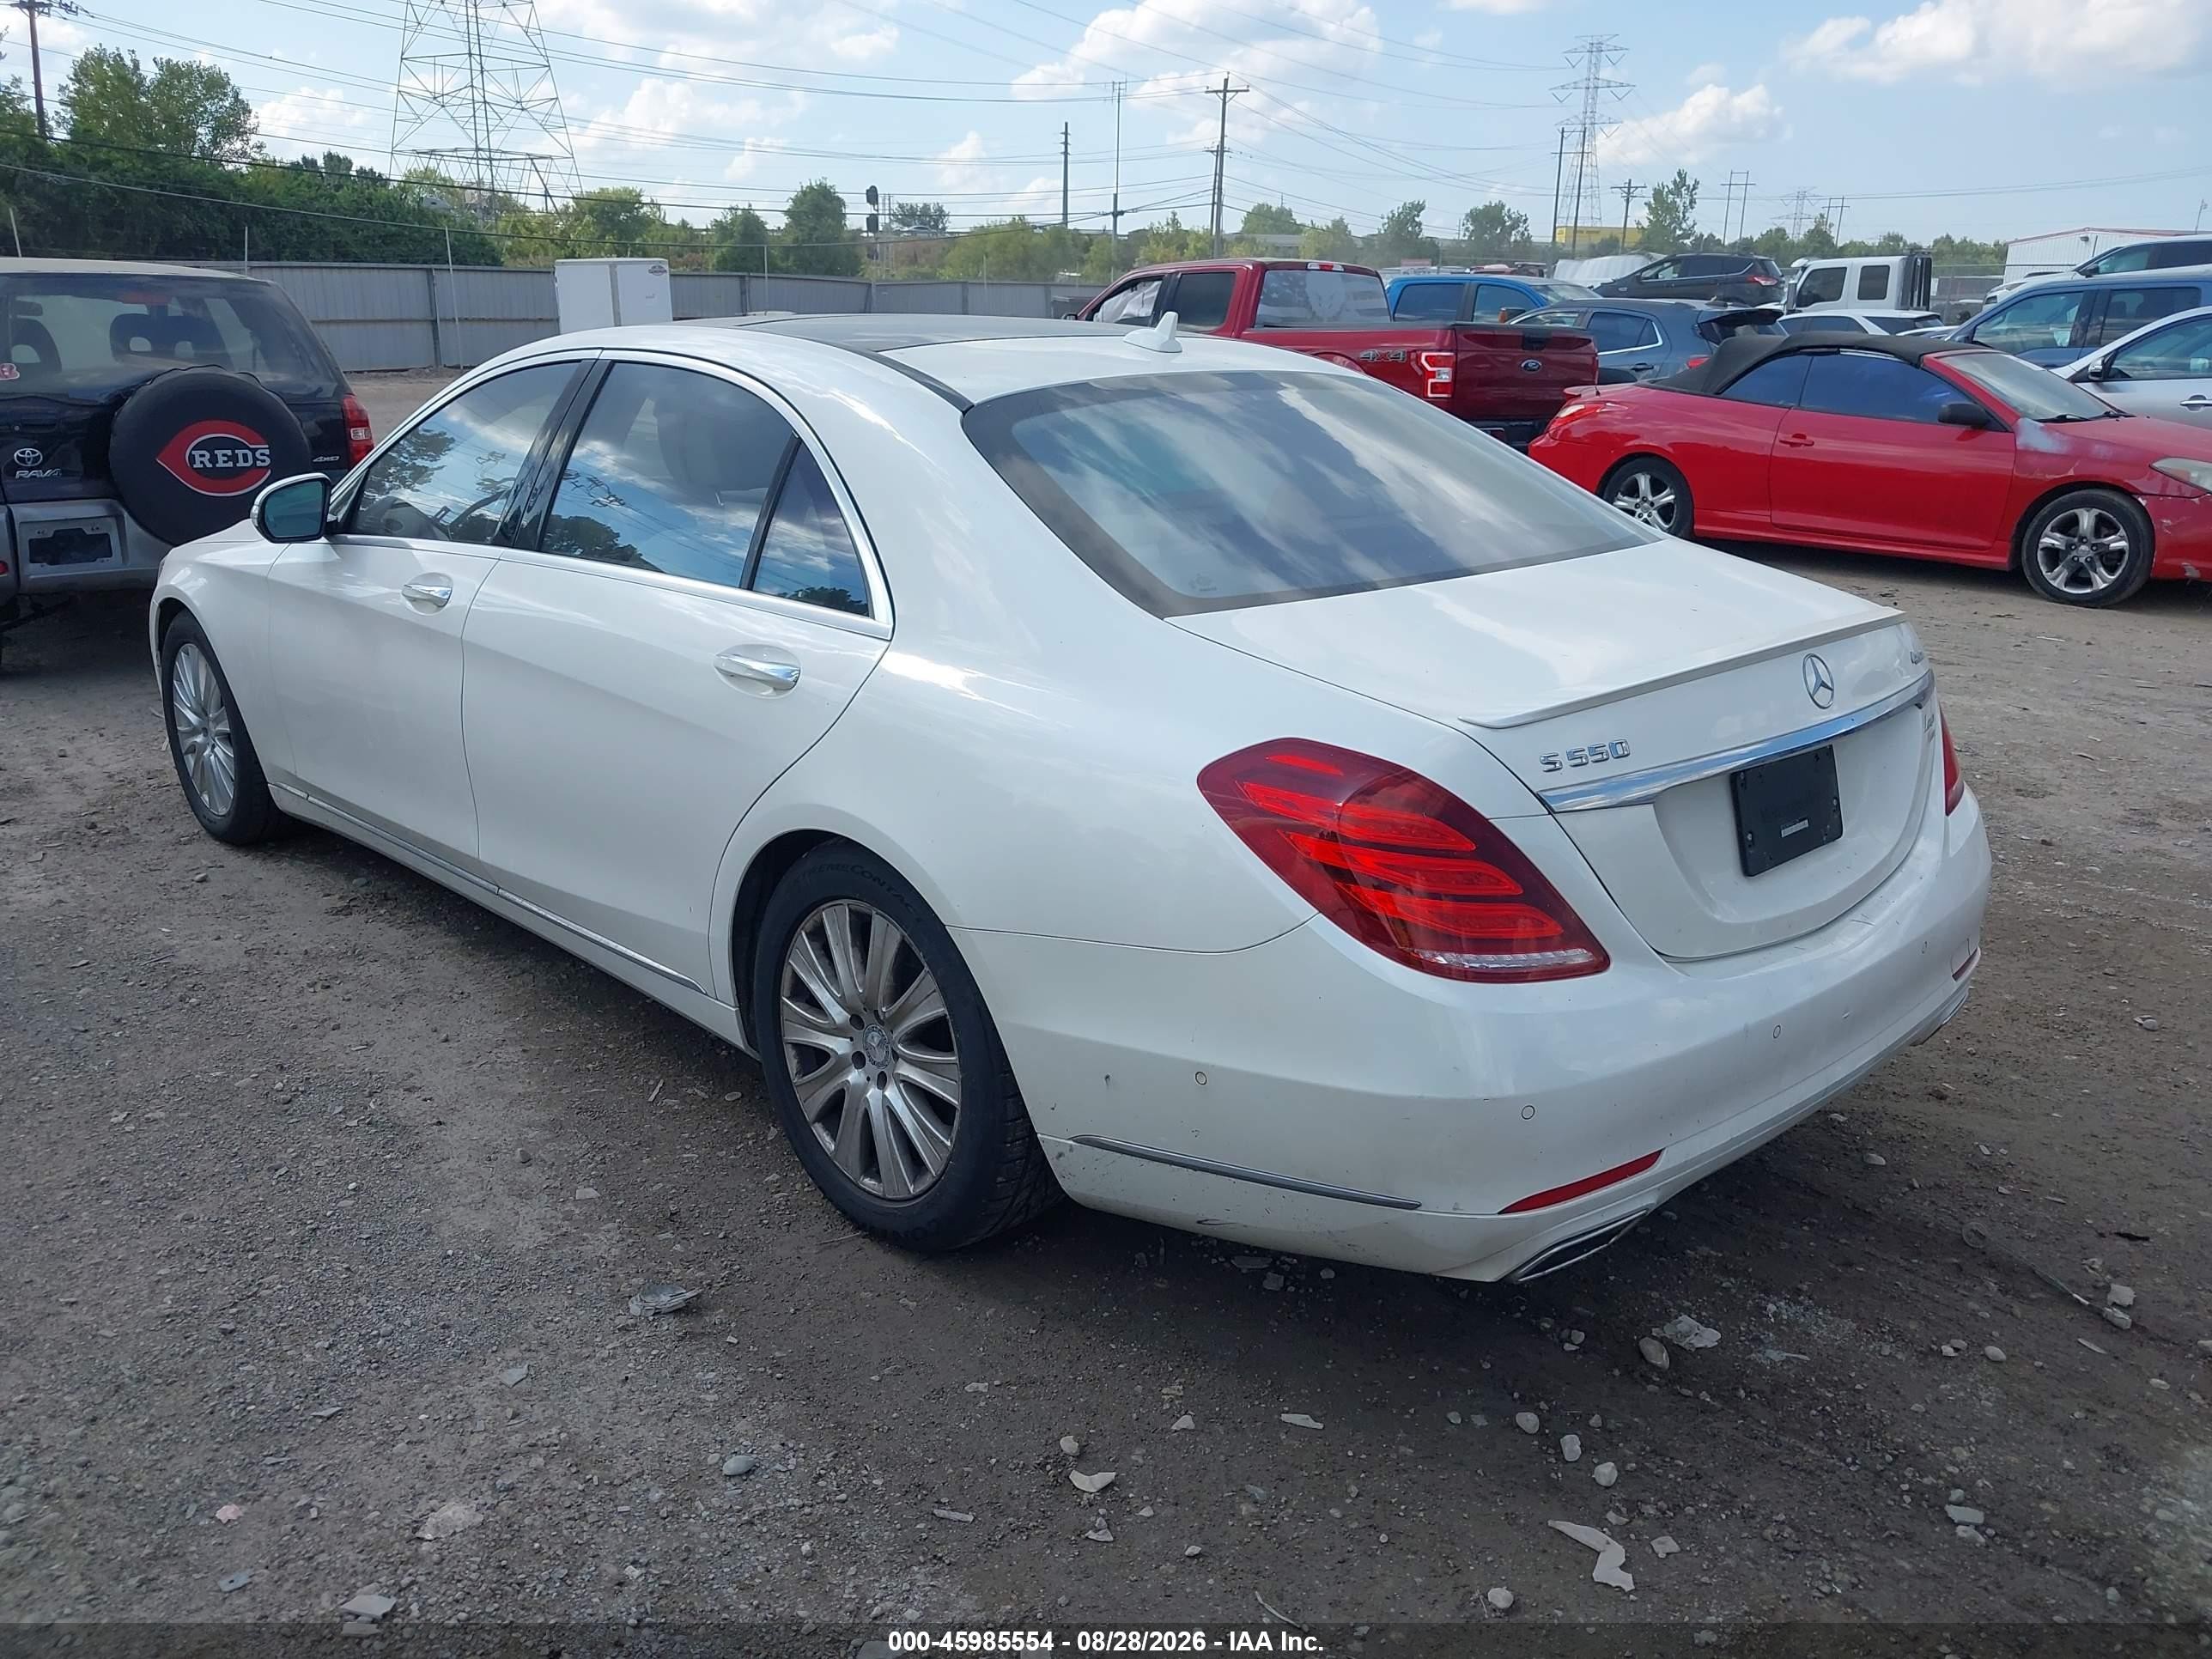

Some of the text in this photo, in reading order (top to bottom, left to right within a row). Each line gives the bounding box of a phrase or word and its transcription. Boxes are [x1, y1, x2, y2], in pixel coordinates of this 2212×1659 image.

[191, 449, 270, 468] REDS
[15, 468, 62, 479] RAV4
[1540, 738, 1631, 773] S 550
